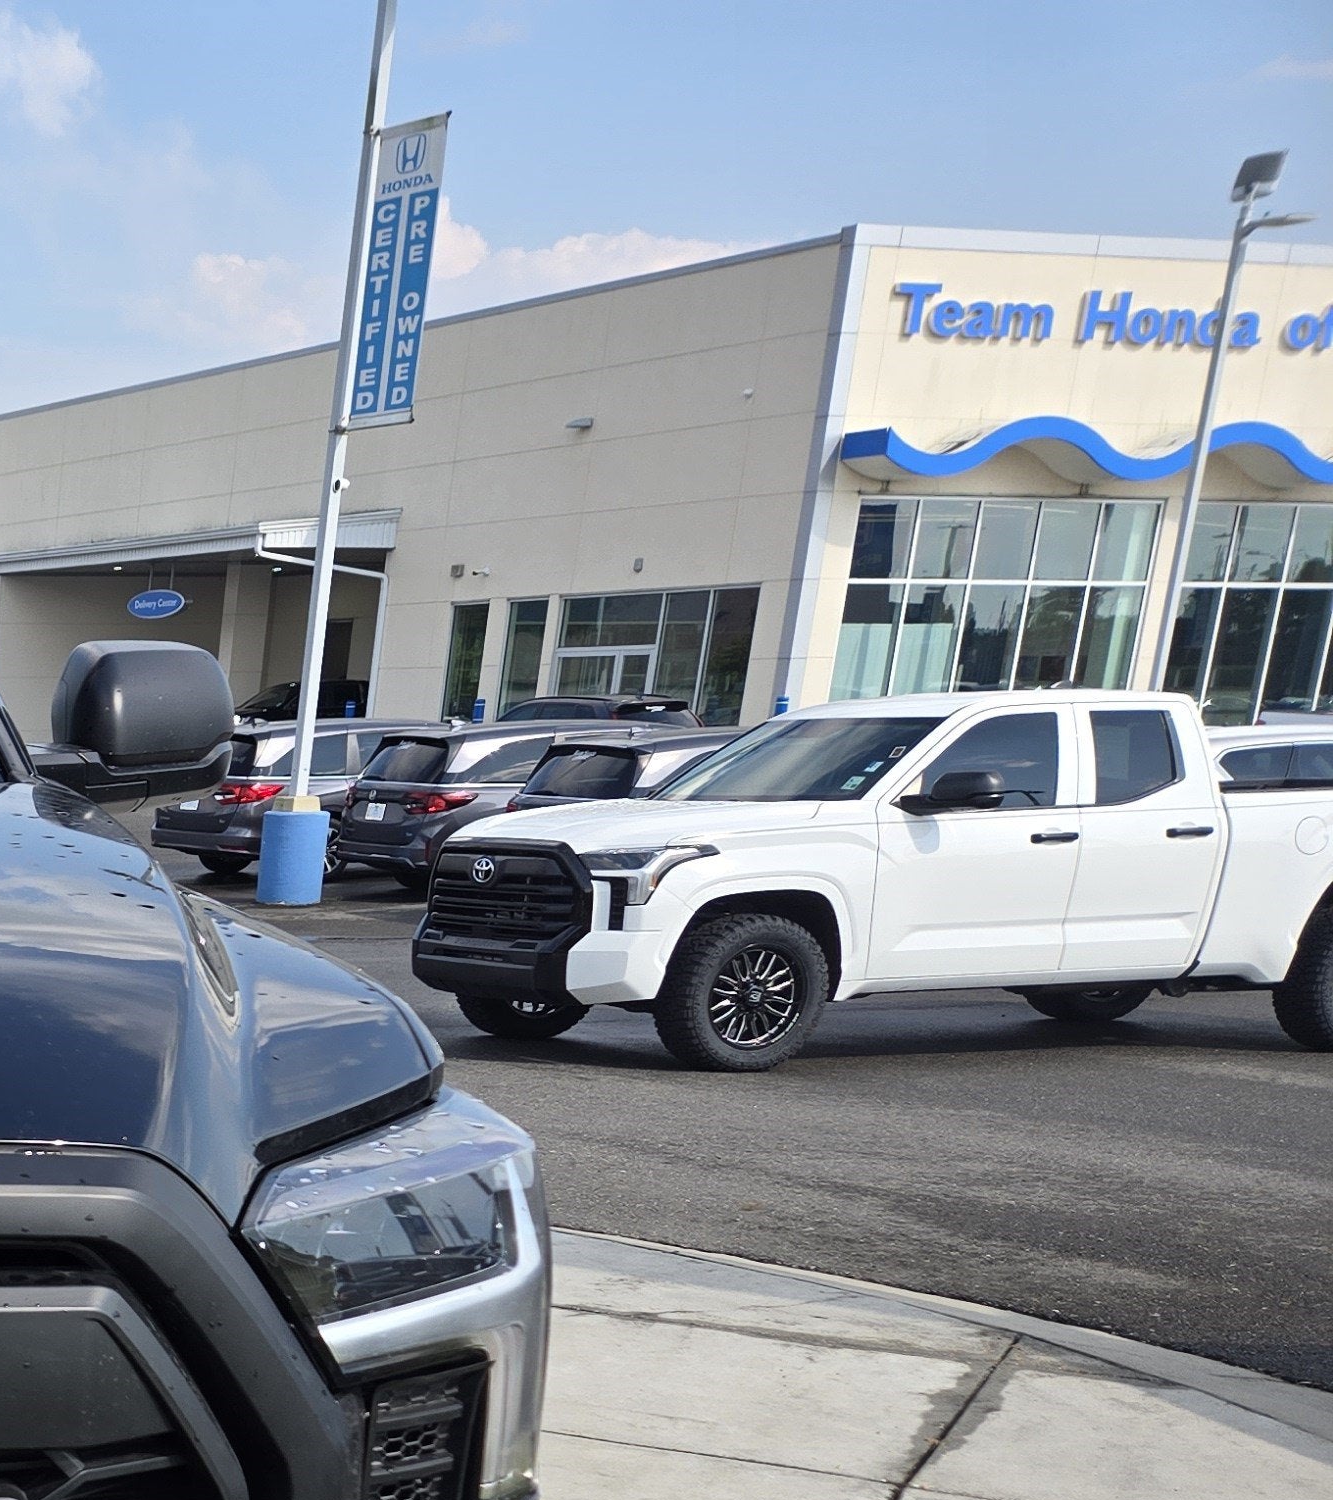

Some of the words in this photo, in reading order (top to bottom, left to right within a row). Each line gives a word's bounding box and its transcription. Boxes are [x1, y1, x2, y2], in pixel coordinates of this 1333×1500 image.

[381, 173, 433, 195] HONDA
[408, 196, 431, 266] PRE
[355, 203, 398, 411] CERTIFIED
[893, 282, 1055, 341] Team
[390, 291, 420, 406] OWNED
